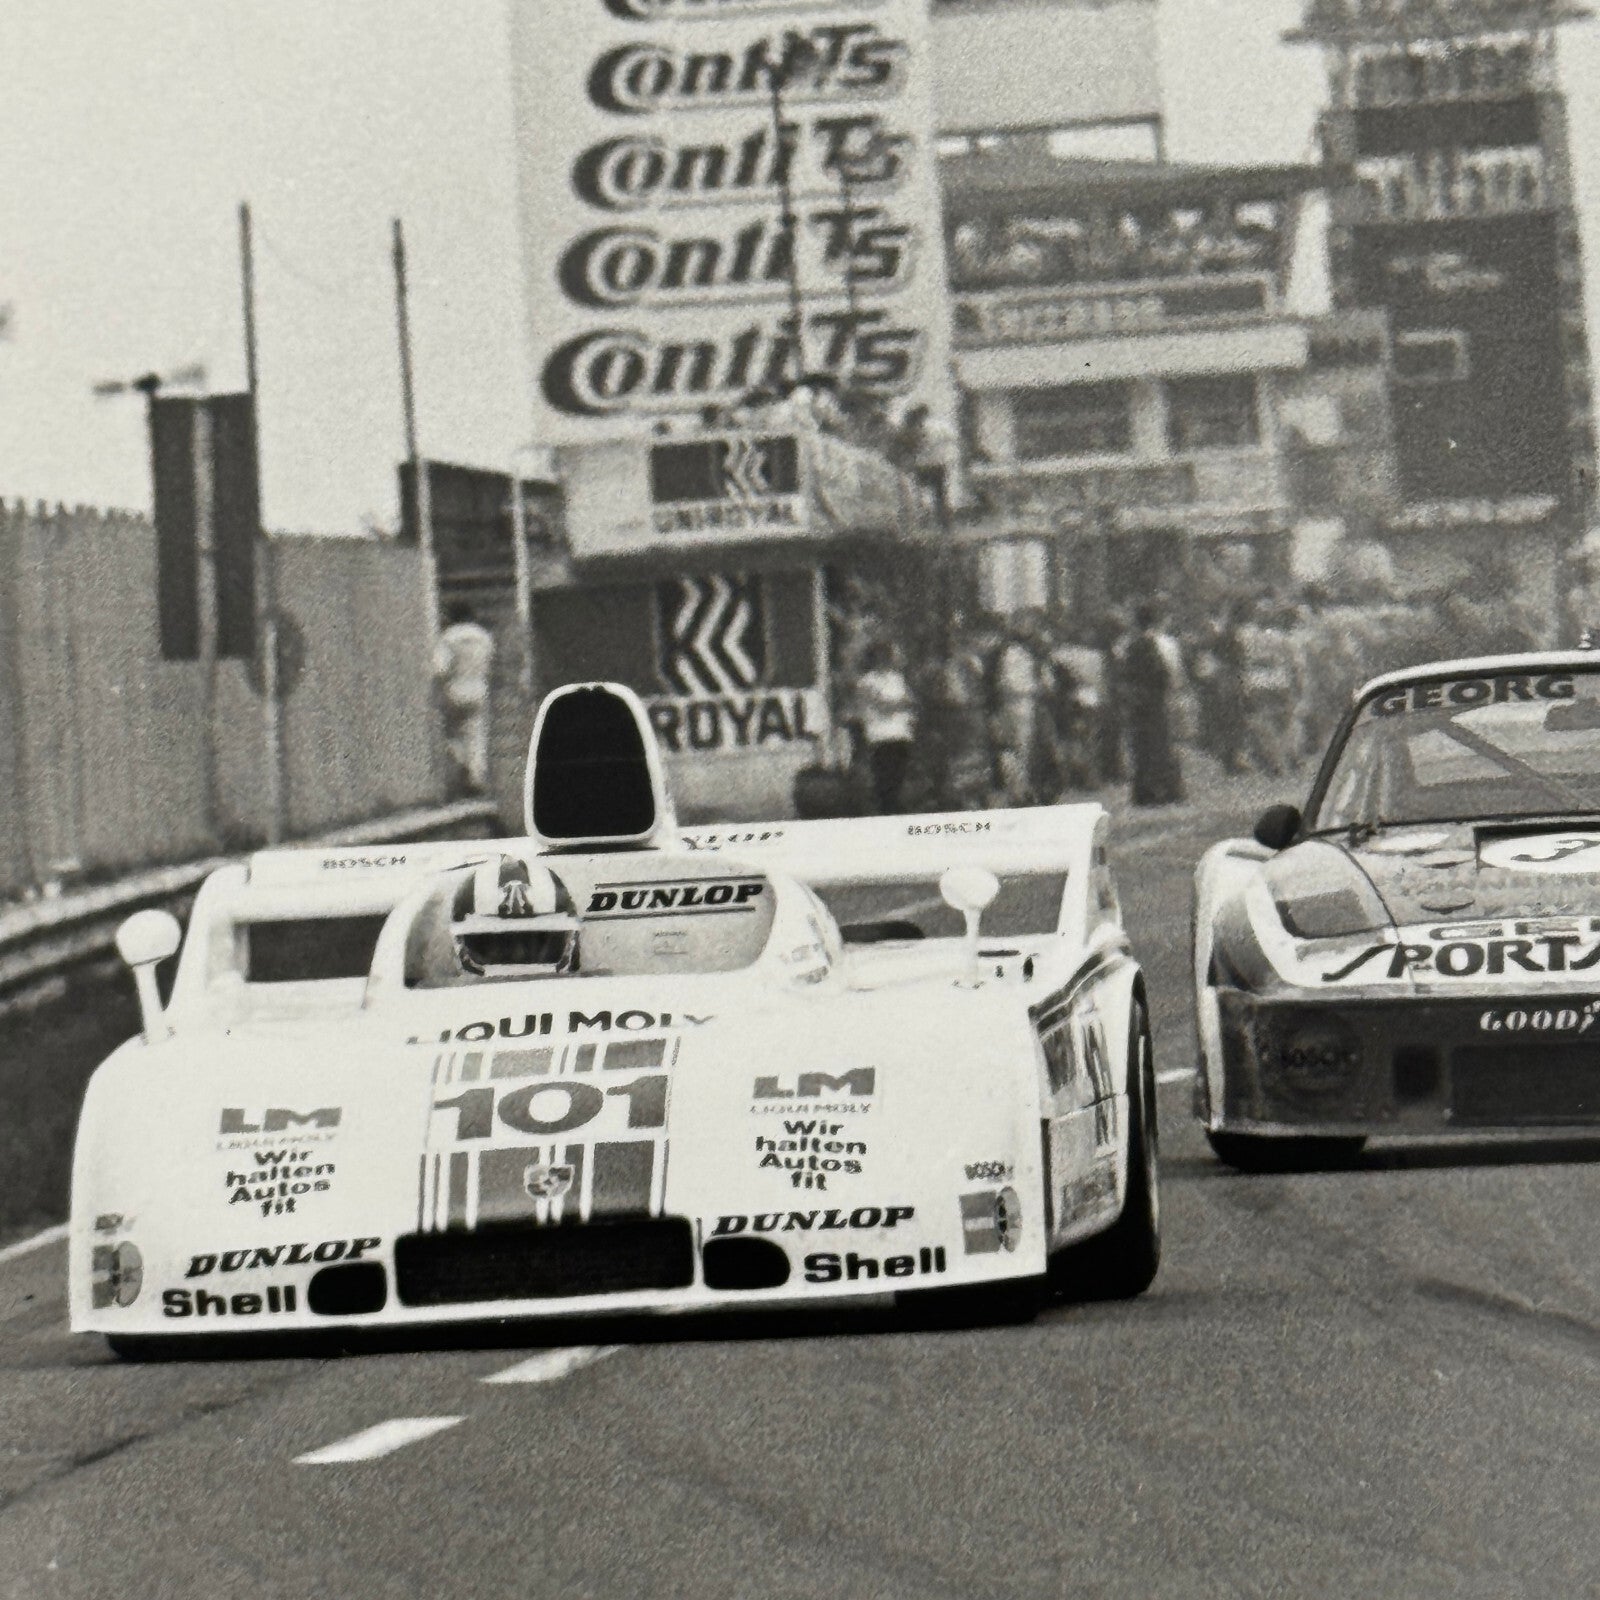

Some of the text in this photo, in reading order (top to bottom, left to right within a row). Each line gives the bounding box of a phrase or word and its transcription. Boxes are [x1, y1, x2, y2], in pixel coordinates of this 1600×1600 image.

[1370, 674, 1576, 719] GEORG
[648, 694, 820, 751] ROYAL
[585, 881, 764, 915] DUNLOP
[405, 1012, 554, 1044] IQUI
[752, 1066, 876, 1099] LM
[219, 1106, 343, 1135] LM
[433, 1074, 669, 1142] 101
[783, 1119, 845, 1136] Wir
[254, 1148, 314, 1166] Wir
[755, 1135, 868, 1155] halten
[226, 1162, 336, 1188] halten
[758, 1152, 863, 1175] Autos
[228, 1178, 332, 1206] Autos
[791, 1170, 828, 1191] fit
[261, 1196, 297, 1218] fit
[711, 1205, 916, 1236] DUNLOP
[184, 1236, 382, 1279] DUNLOP
[803, 1245, 947, 1284] Shell
[161, 1284, 297, 1319] Shell
